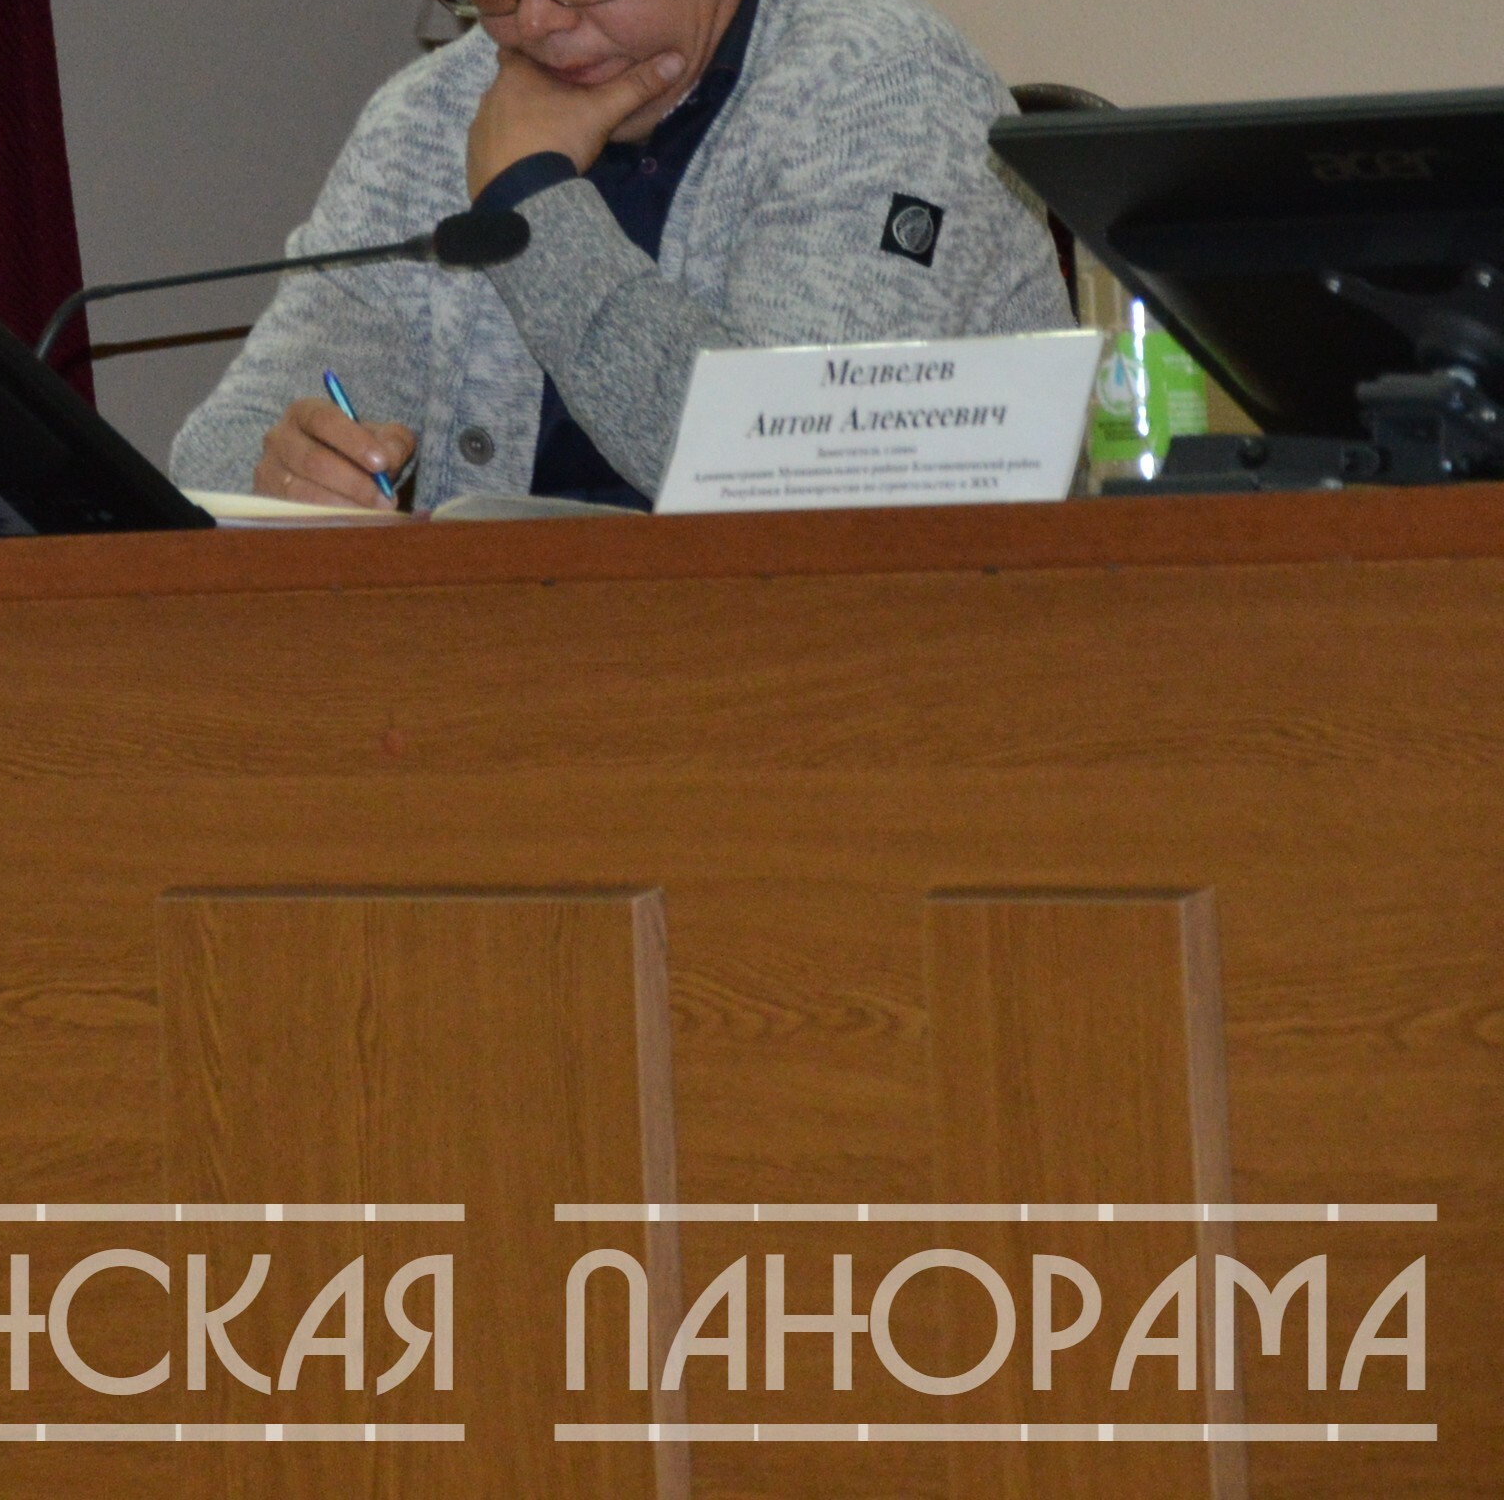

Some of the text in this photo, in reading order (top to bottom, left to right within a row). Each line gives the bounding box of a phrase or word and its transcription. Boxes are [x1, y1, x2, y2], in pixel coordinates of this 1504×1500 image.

[821, 359, 955, 387] Медведев
[747, 405, 1008, 438] Антон Алексеевич
